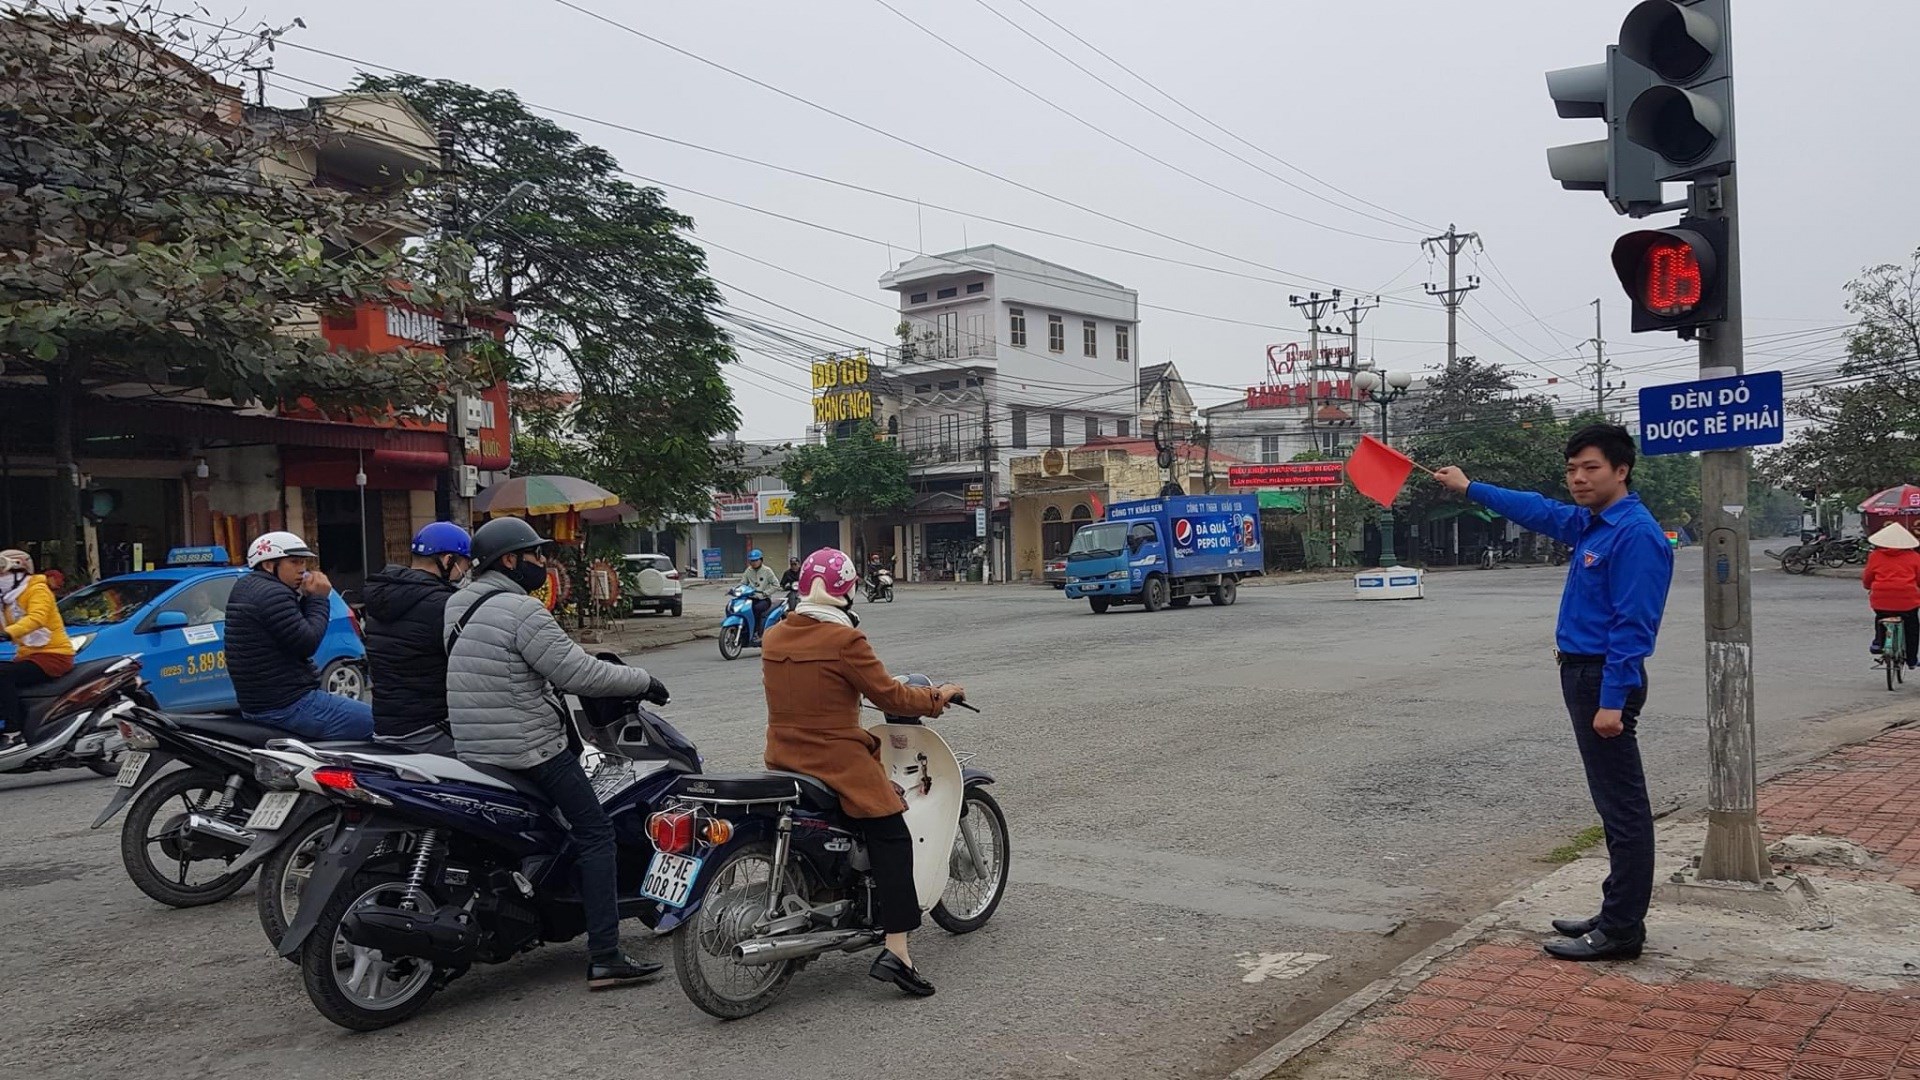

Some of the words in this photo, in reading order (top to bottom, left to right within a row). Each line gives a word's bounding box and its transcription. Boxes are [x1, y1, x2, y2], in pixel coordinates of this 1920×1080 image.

[1652, 244, 1701, 308] 05
[812, 393, 847, 422] TRANG
[848, 390, 872, 419] NGA
[1296, 380, 1331, 406] HM
[1670, 388, 1713, 410] ĐÈN
[1718, 380, 1750, 406] ĐỎ
[1646, 419, 1699, 443] ĐƯỢC
[1704, 411, 1727, 435] RẼ
[1733, 404, 1779, 432] PHẢI
[1196, 521, 1208, 535] ĐÃ
[1209, 520, 1227, 534] QUÁ
[1197, 537, 1218, 550] PEPSI
[657, 854, 693, 881] 15-AE
[644, 873, 688, 903] 008.17
